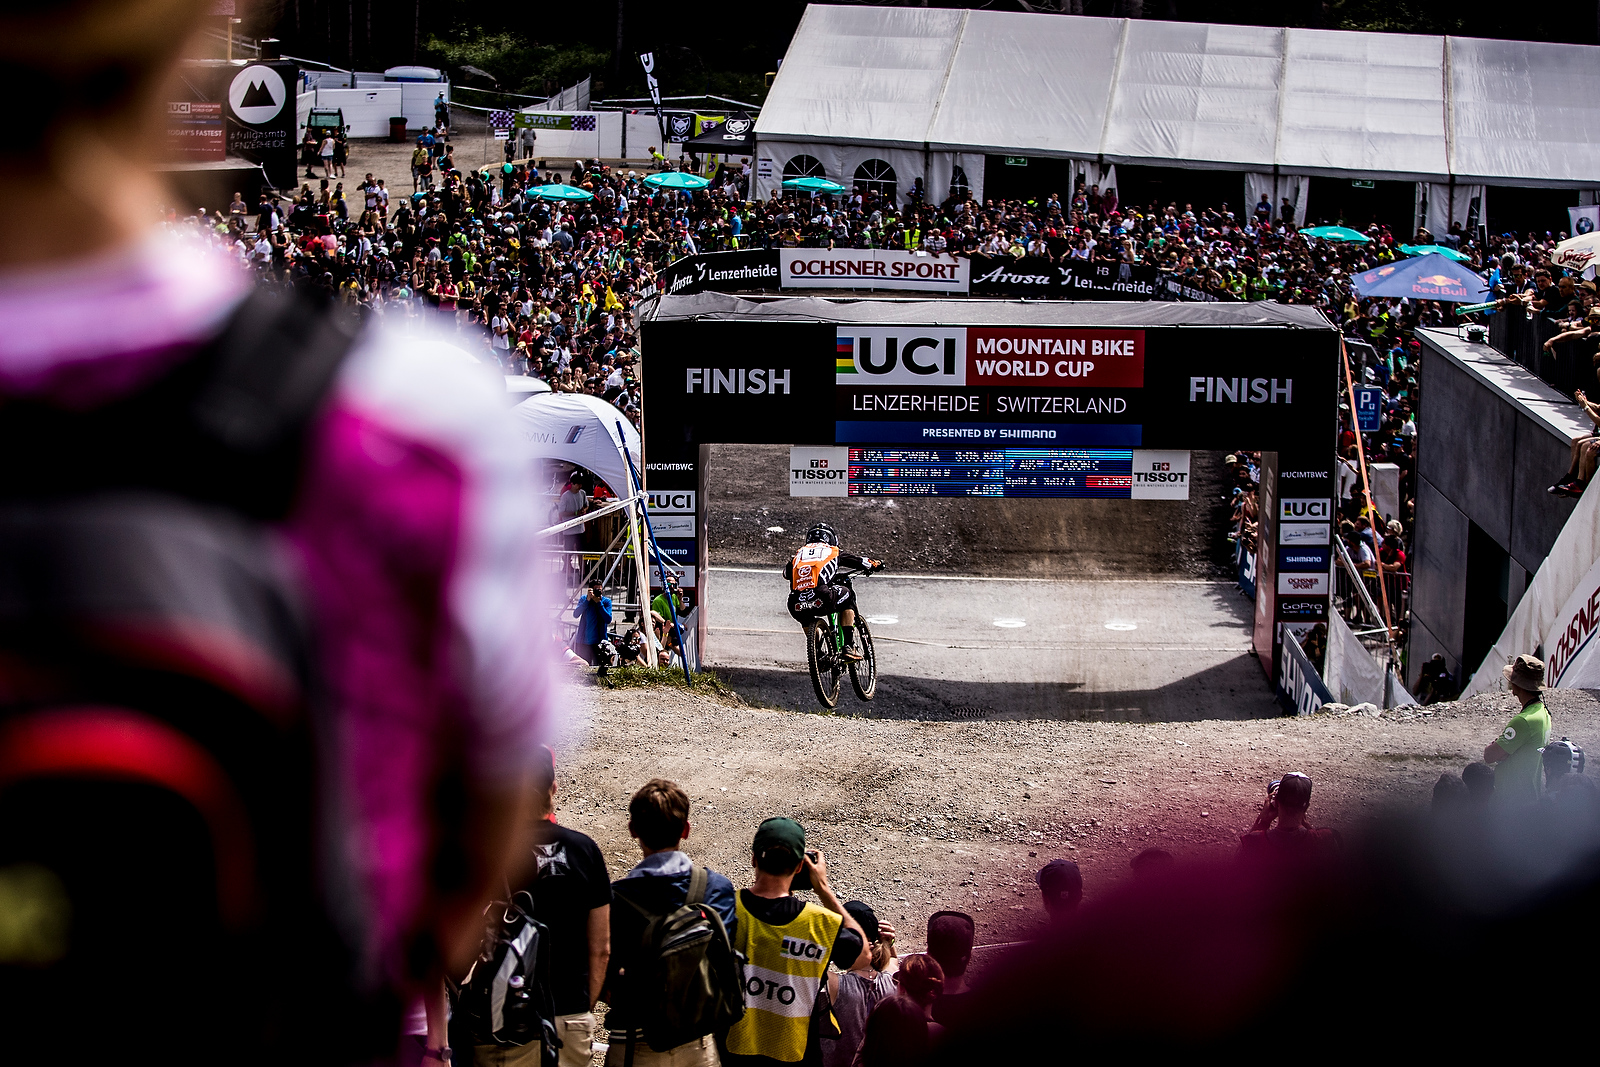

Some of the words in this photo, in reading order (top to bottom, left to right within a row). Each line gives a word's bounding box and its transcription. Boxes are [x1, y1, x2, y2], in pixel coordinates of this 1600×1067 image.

[524, 115, 562, 125] START
[230, 140, 286, 150] LENZERHEIDE
[708, 264, 778, 282] Lenzerheide
[790, 260, 886, 276] OCHSNER
[890, 261, 960, 280] SPORT
[973, 266, 1050, 285] Arosa
[1412, 284, 1439, 294] Red
[1440, 286, 1468, 296] Bull
[859, 336, 956, 376] UCI
[976, 338, 1088, 356] MOUNTAIN
[1092, 339, 1134, 356] BIKE
[976, 360, 1052, 378] WORLD
[1054, 360, 1095, 378] CUP
[686, 368, 791, 395] FINISH
[1189, 376, 1293, 404] FINISH
[853, 394, 980, 412] LENZERHEIDE
[996, 396, 1126, 414] SWITZERLAND
[1360, 391, 1371, 409] P
[922, 428, 982, 438] PRESENTED
[983, 428, 996, 438] BY
[1000, 430, 1057, 439] SHIMANO
[646, 463, 694, 471] #UCIMTBWC
[792, 470, 846, 479] TISSOT
[1281, 471, 1328, 479] #UCIMTBWC
[1134, 472, 1188, 482] TISSOT
[656, 494, 691, 508] UCI
[1293, 502, 1326, 516] UCI
[790, 941, 822, 960] UCI
[747, 976, 796, 1006] OTO
